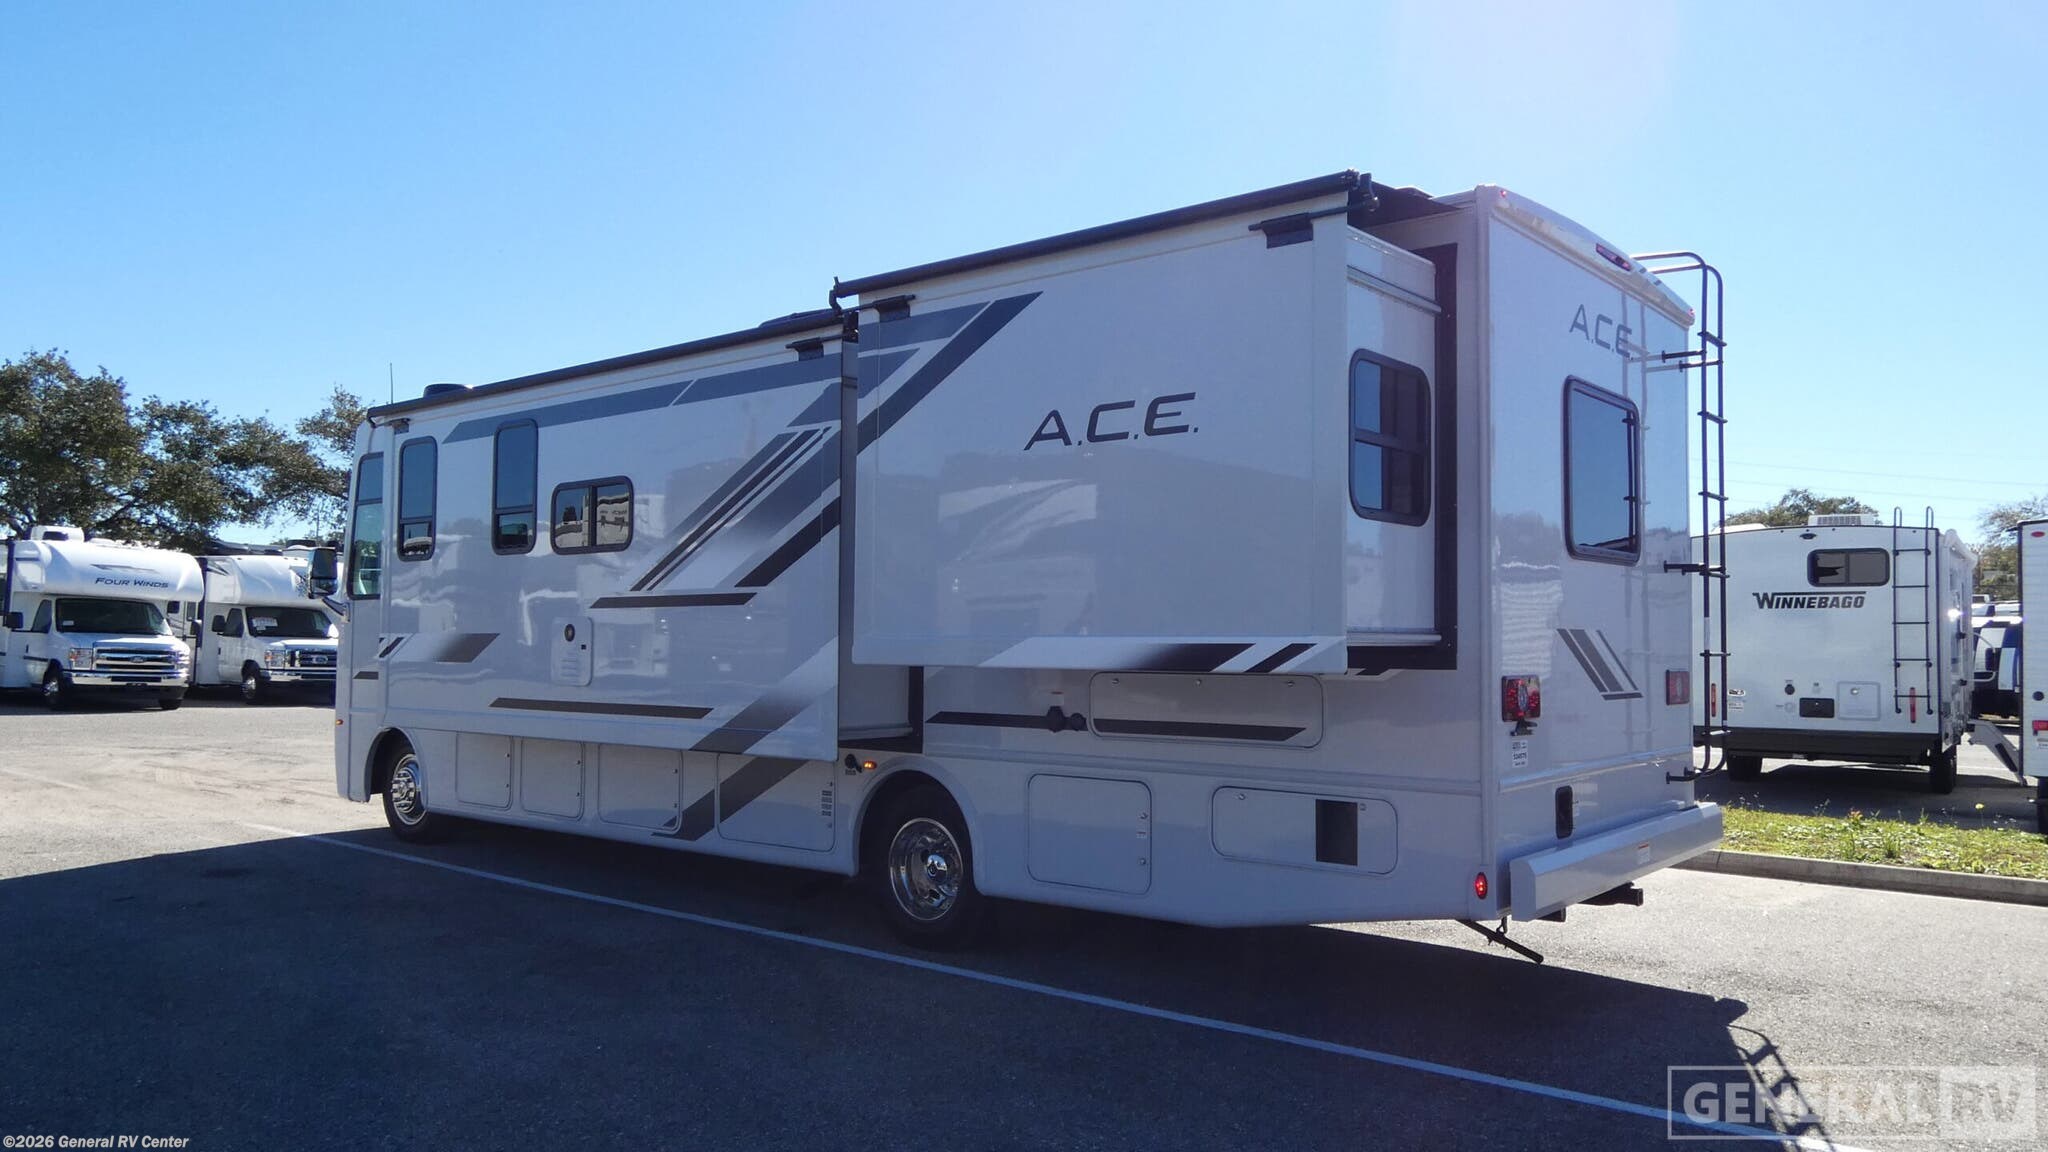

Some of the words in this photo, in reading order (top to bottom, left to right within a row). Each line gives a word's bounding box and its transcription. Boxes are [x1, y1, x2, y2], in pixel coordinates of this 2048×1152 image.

[1569, 303, 1634, 361] A.C.E.
[1023, 391, 1199, 451] A.C.E.
[95, 577, 130, 586] FOUR
[133, 579, 169, 588] WINDS
[1752, 591, 1867, 609] WINNEBAGO
